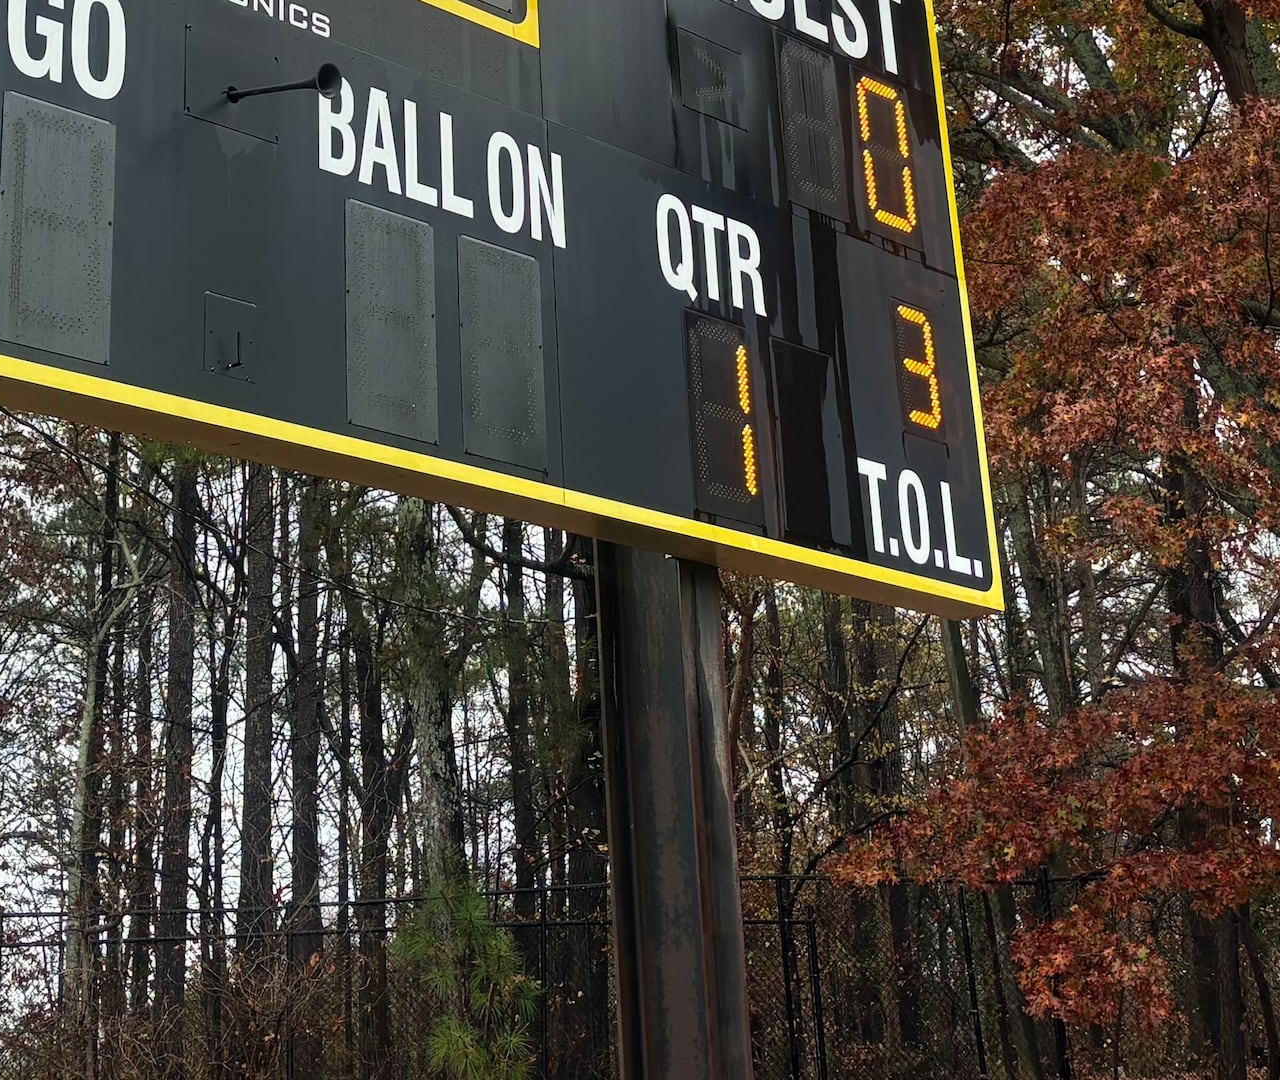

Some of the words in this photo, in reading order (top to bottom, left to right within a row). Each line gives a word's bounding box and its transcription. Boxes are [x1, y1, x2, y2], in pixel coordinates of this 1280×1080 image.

[317, 76, 474, 219] BALL
[487, 131, 567, 249] ON
[856, 76, 916, 233] 0
[656, 193, 767, 317] QTR
[735, 344, 757, 496] 1
[897, 305, 941, 429] 3
[857, 457, 984, 578] T.O.L.
